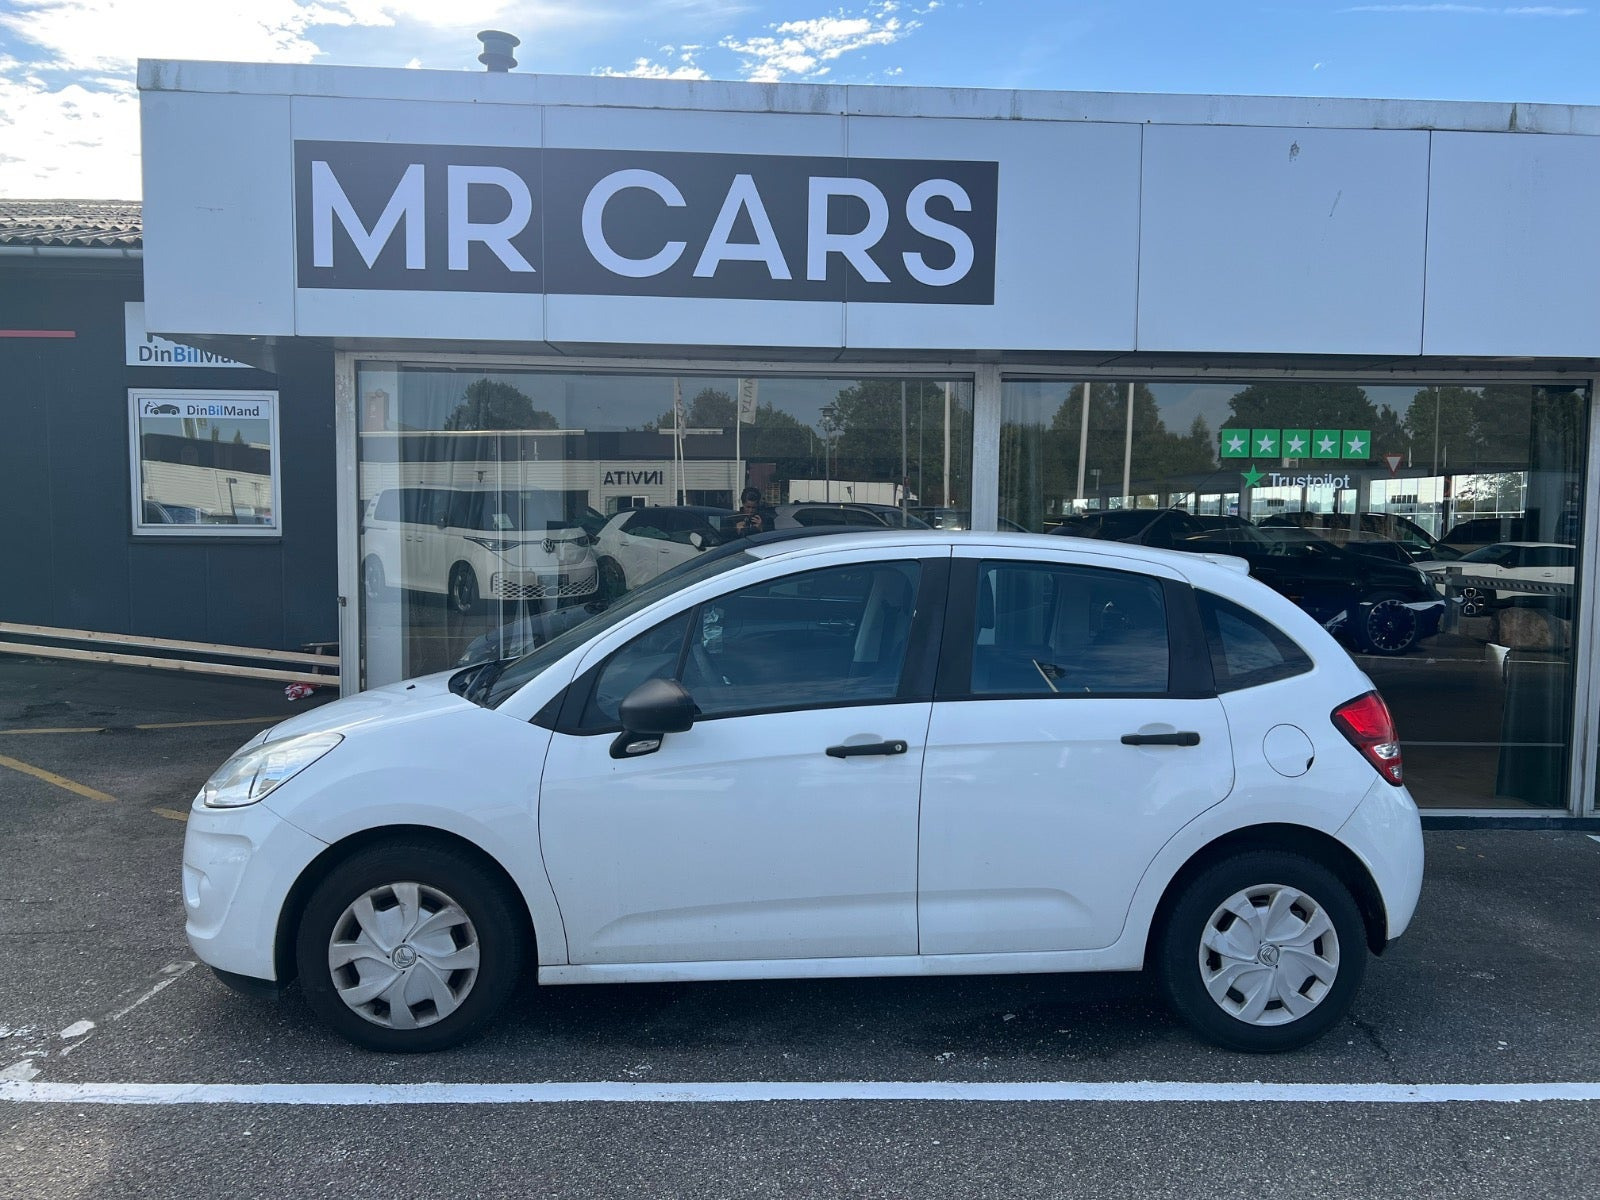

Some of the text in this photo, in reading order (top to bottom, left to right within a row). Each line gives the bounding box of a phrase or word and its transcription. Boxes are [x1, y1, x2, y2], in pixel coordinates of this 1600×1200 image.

[311, 160, 974, 287] MR CARS
[187, 405, 260, 416] DinBilMand
[1268, 472, 1350, 492] Trustpilot
